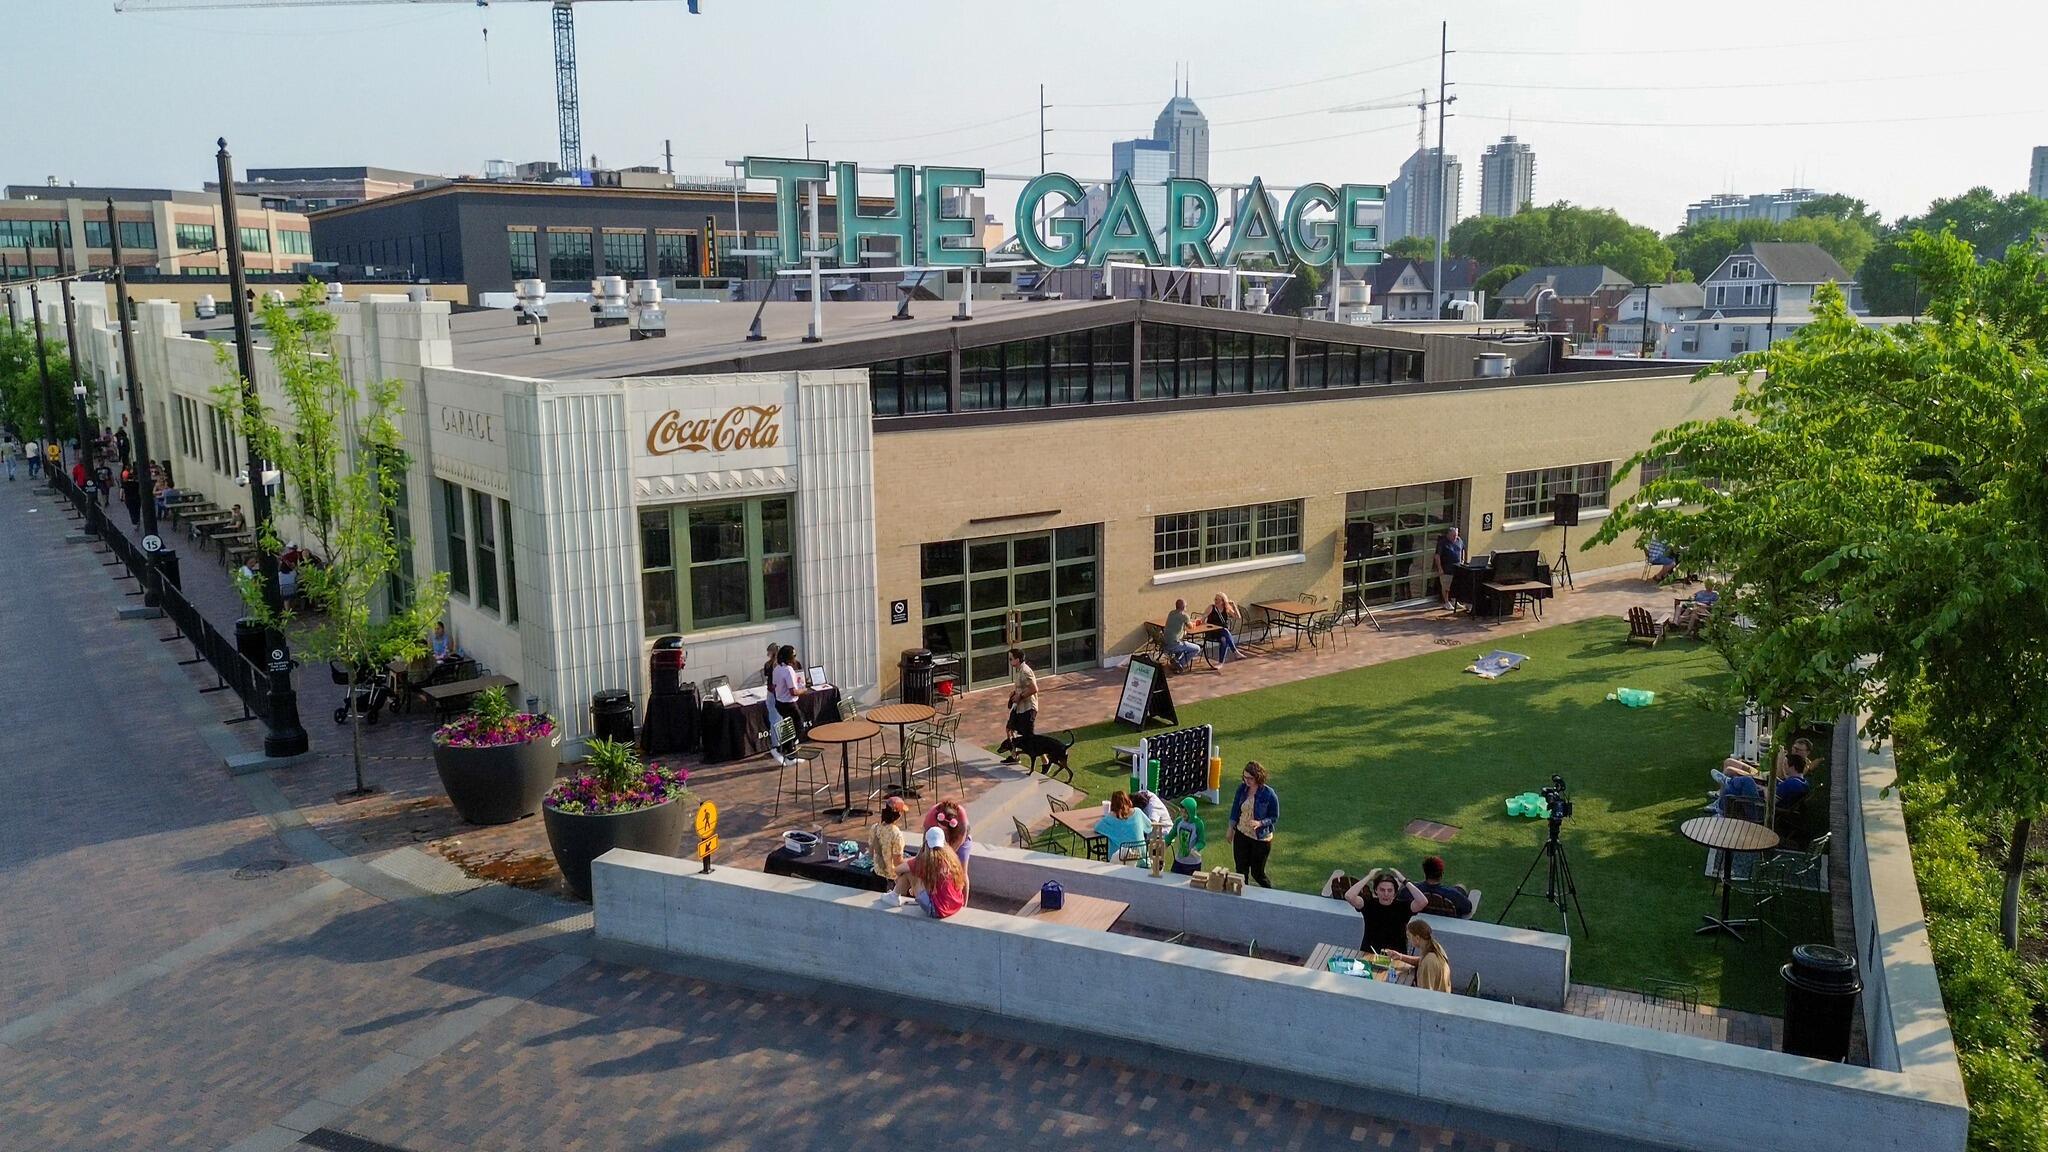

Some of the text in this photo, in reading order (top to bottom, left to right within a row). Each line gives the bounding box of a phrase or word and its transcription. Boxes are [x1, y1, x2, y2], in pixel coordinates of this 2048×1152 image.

[743, 155, 1387, 268] THE GARAGE
[441, 405, 495, 443] GARAGE
[647, 403, 783, 456] Coca-Cola
[146, 540, 158, 550] 15
